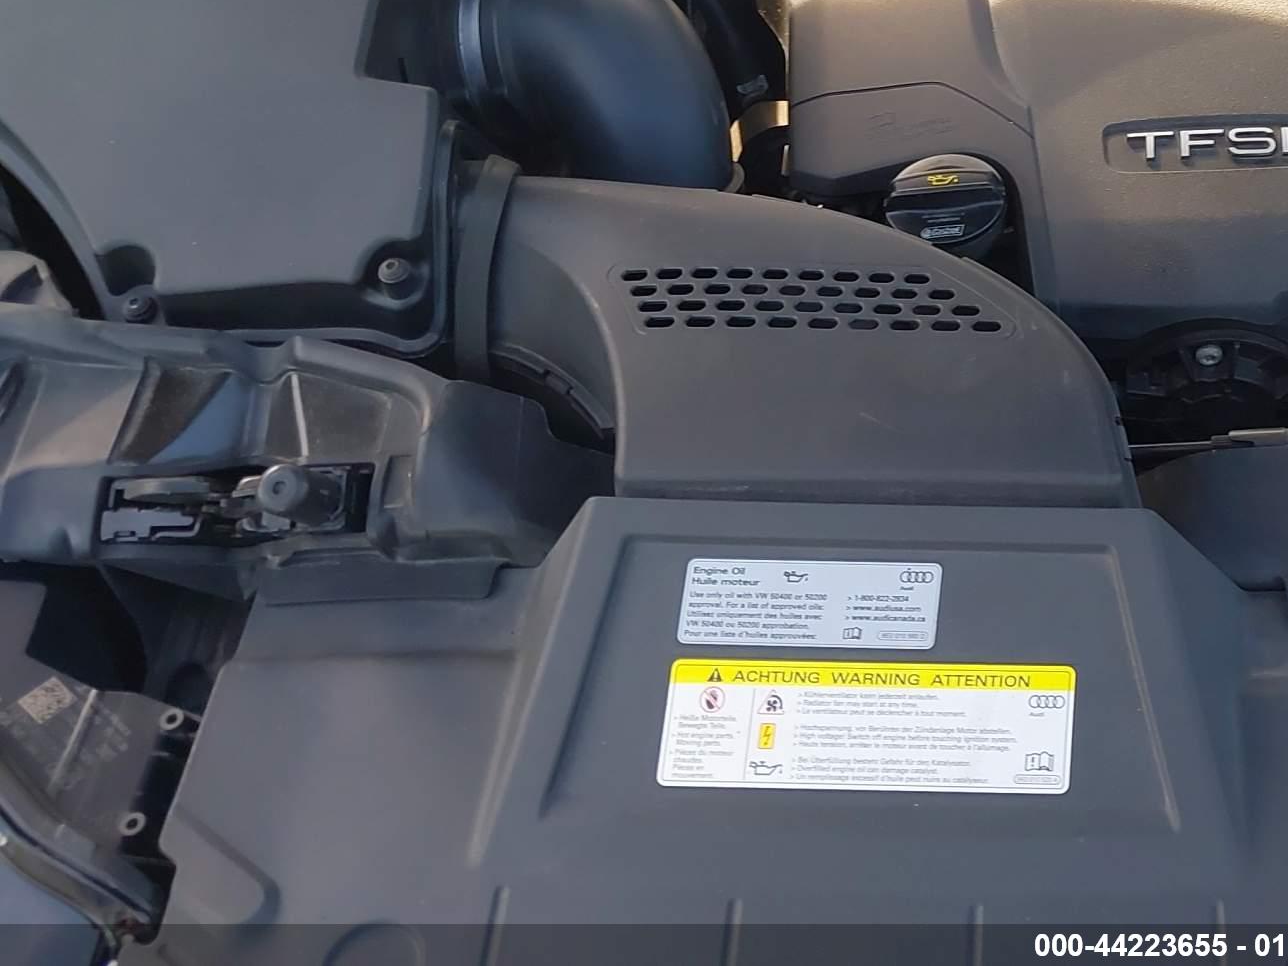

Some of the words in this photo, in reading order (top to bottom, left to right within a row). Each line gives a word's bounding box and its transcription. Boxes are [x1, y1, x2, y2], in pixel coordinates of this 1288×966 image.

[693, 566, 729, 576] Engine
[731, 567, 746, 575] Oil
[691, 577, 718, 585] Huile
[706, 592, 722, 600] only
[732, 669, 821, 685] ACHTUNG
[831, 671, 921, 686] WARNING
[930, 673, 1031, 688] ATTENTION
